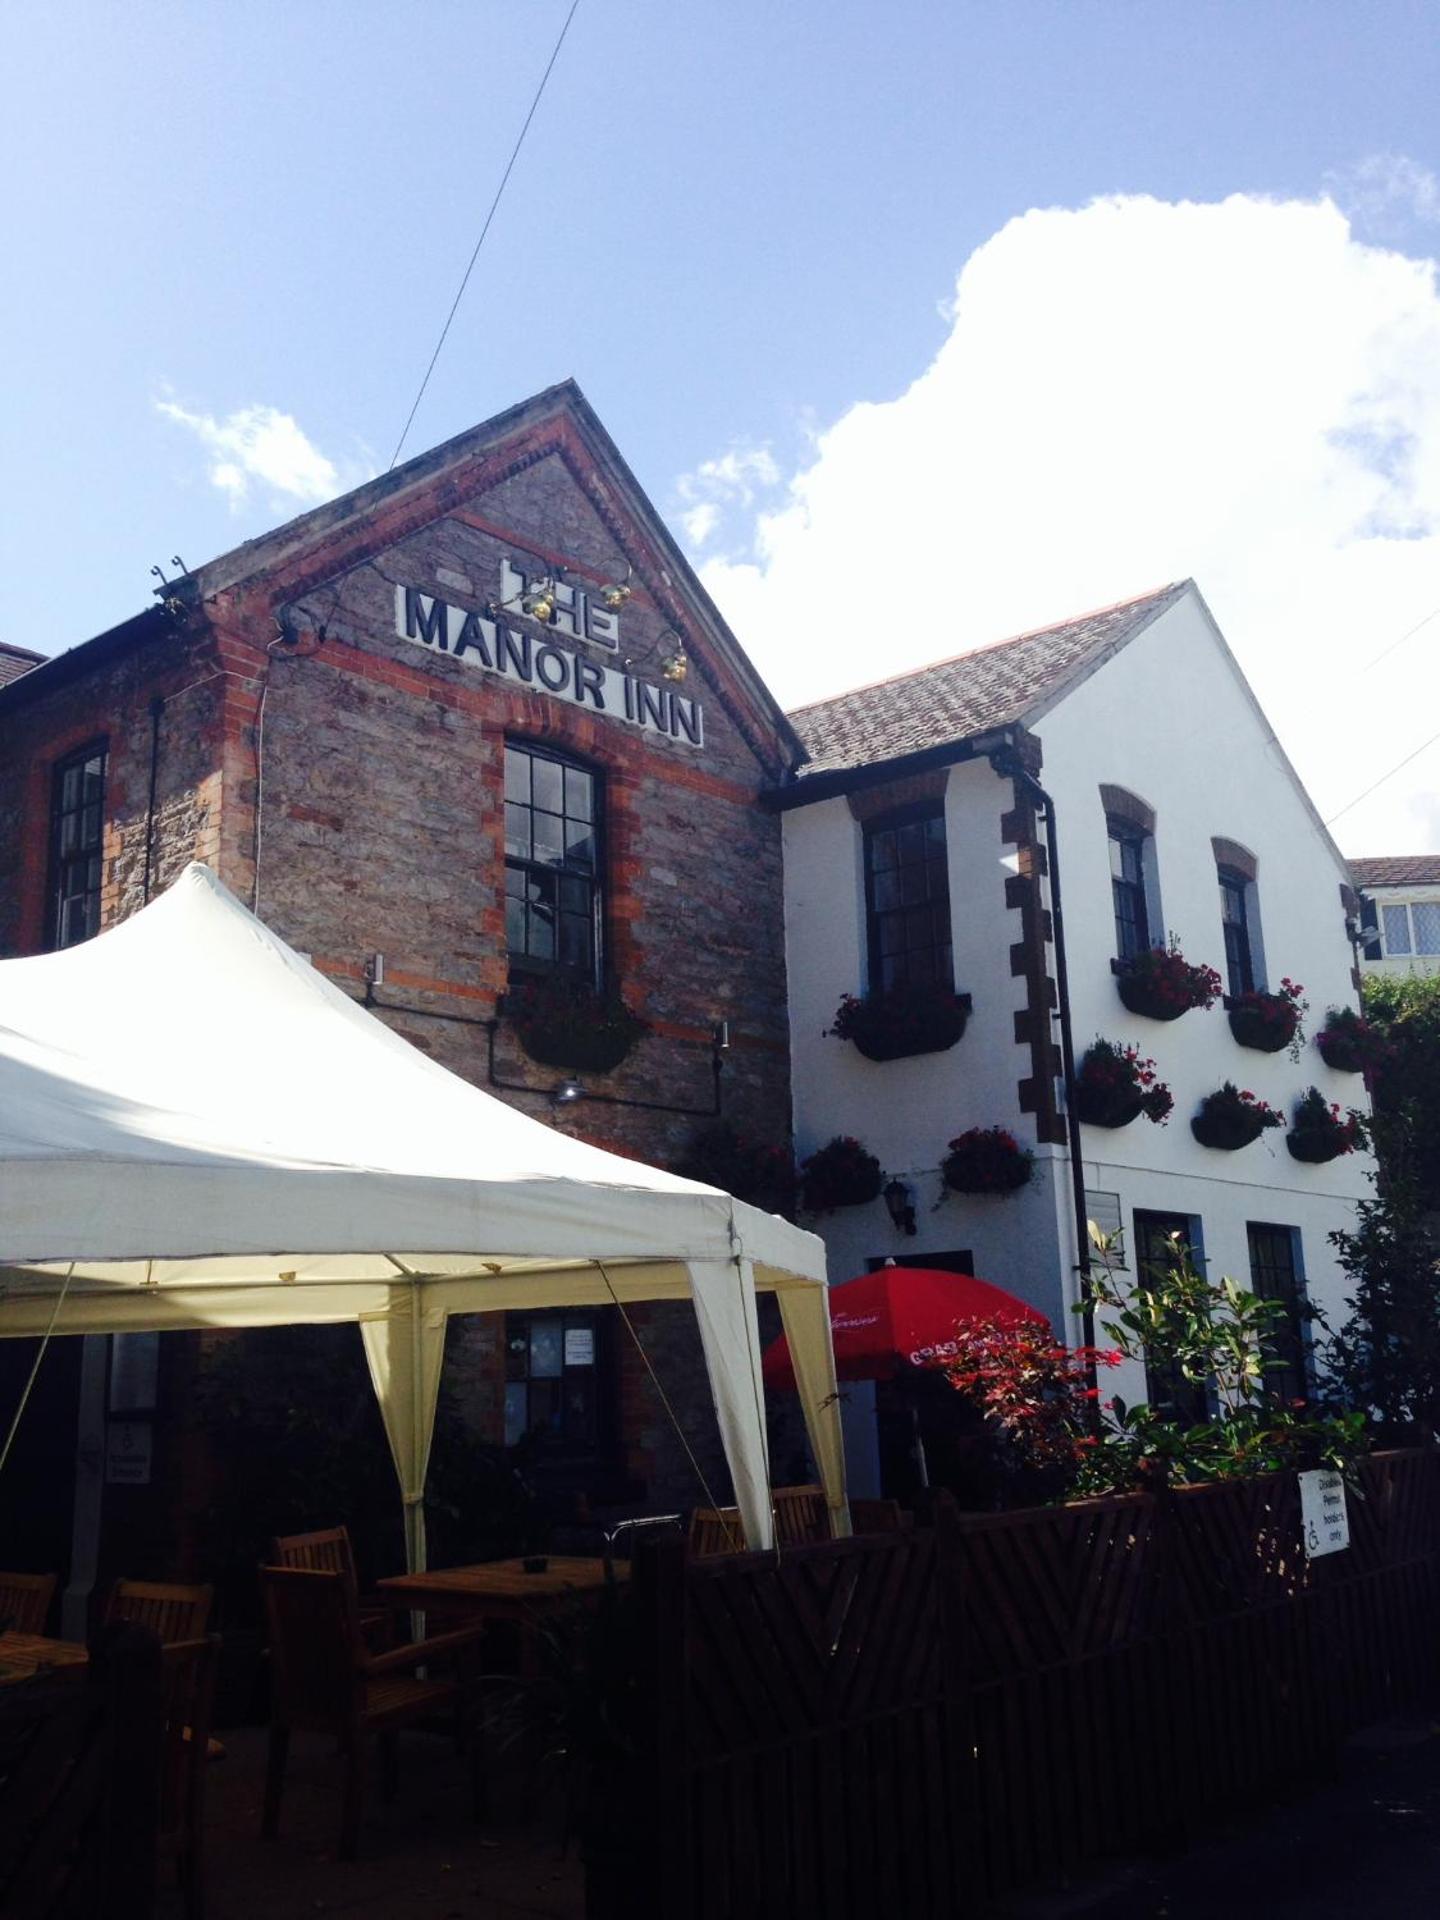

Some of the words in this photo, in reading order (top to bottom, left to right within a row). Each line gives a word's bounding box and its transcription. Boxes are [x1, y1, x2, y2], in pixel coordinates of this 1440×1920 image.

[405, 588, 606, 709] MANOR
[624, 675, 701, 745] INN
[510, 562, 618, 650] THE
